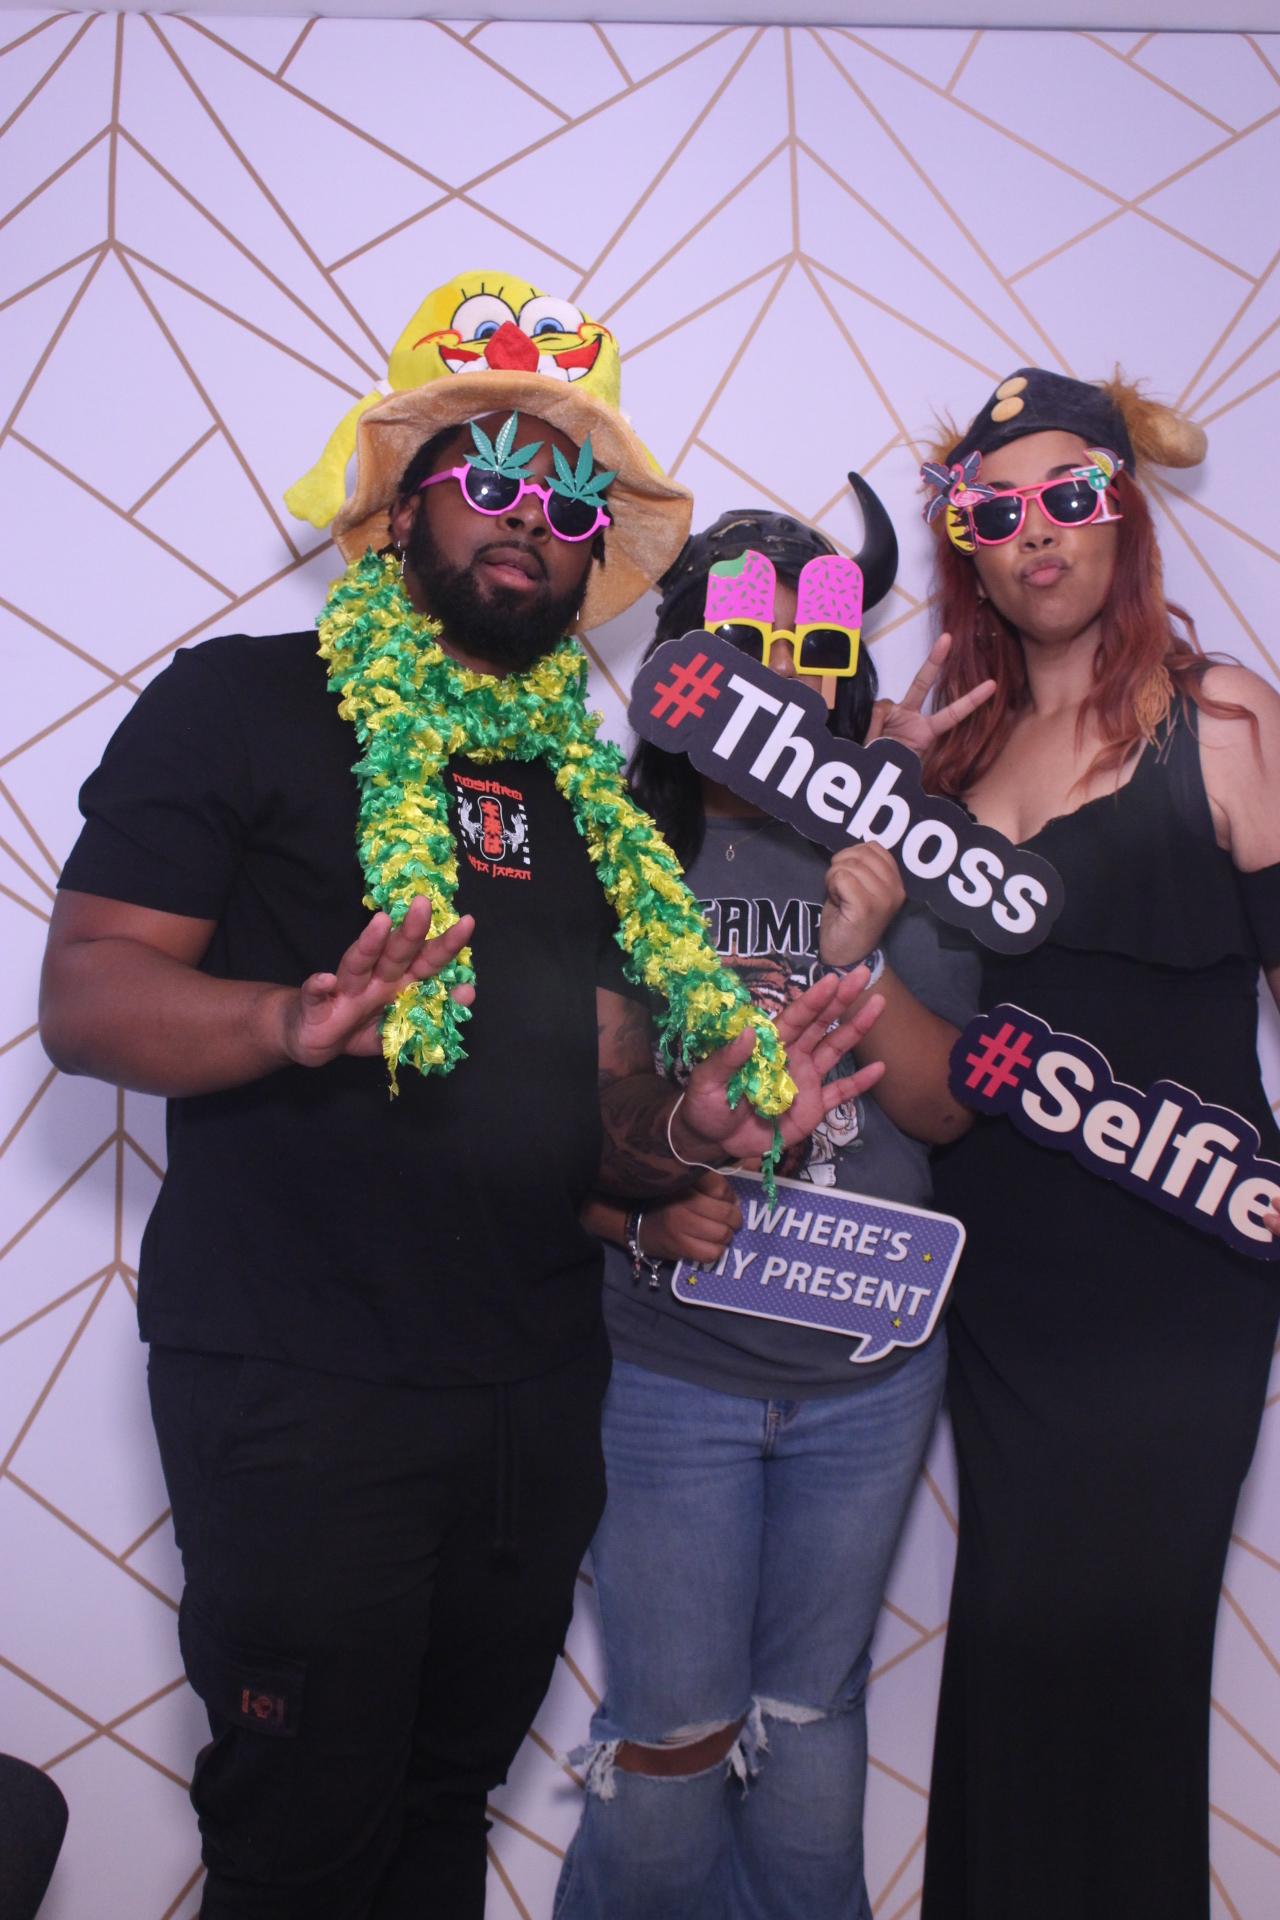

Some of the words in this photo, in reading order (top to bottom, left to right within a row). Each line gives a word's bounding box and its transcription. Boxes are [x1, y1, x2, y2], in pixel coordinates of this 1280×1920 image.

[650, 652, 1048, 934] #Theboss
[965, 1022, 1280, 1243] #Selfie
[747, 1200, 912, 1262] WHERE'S
[760, 1256, 931, 1316] PRESENT
